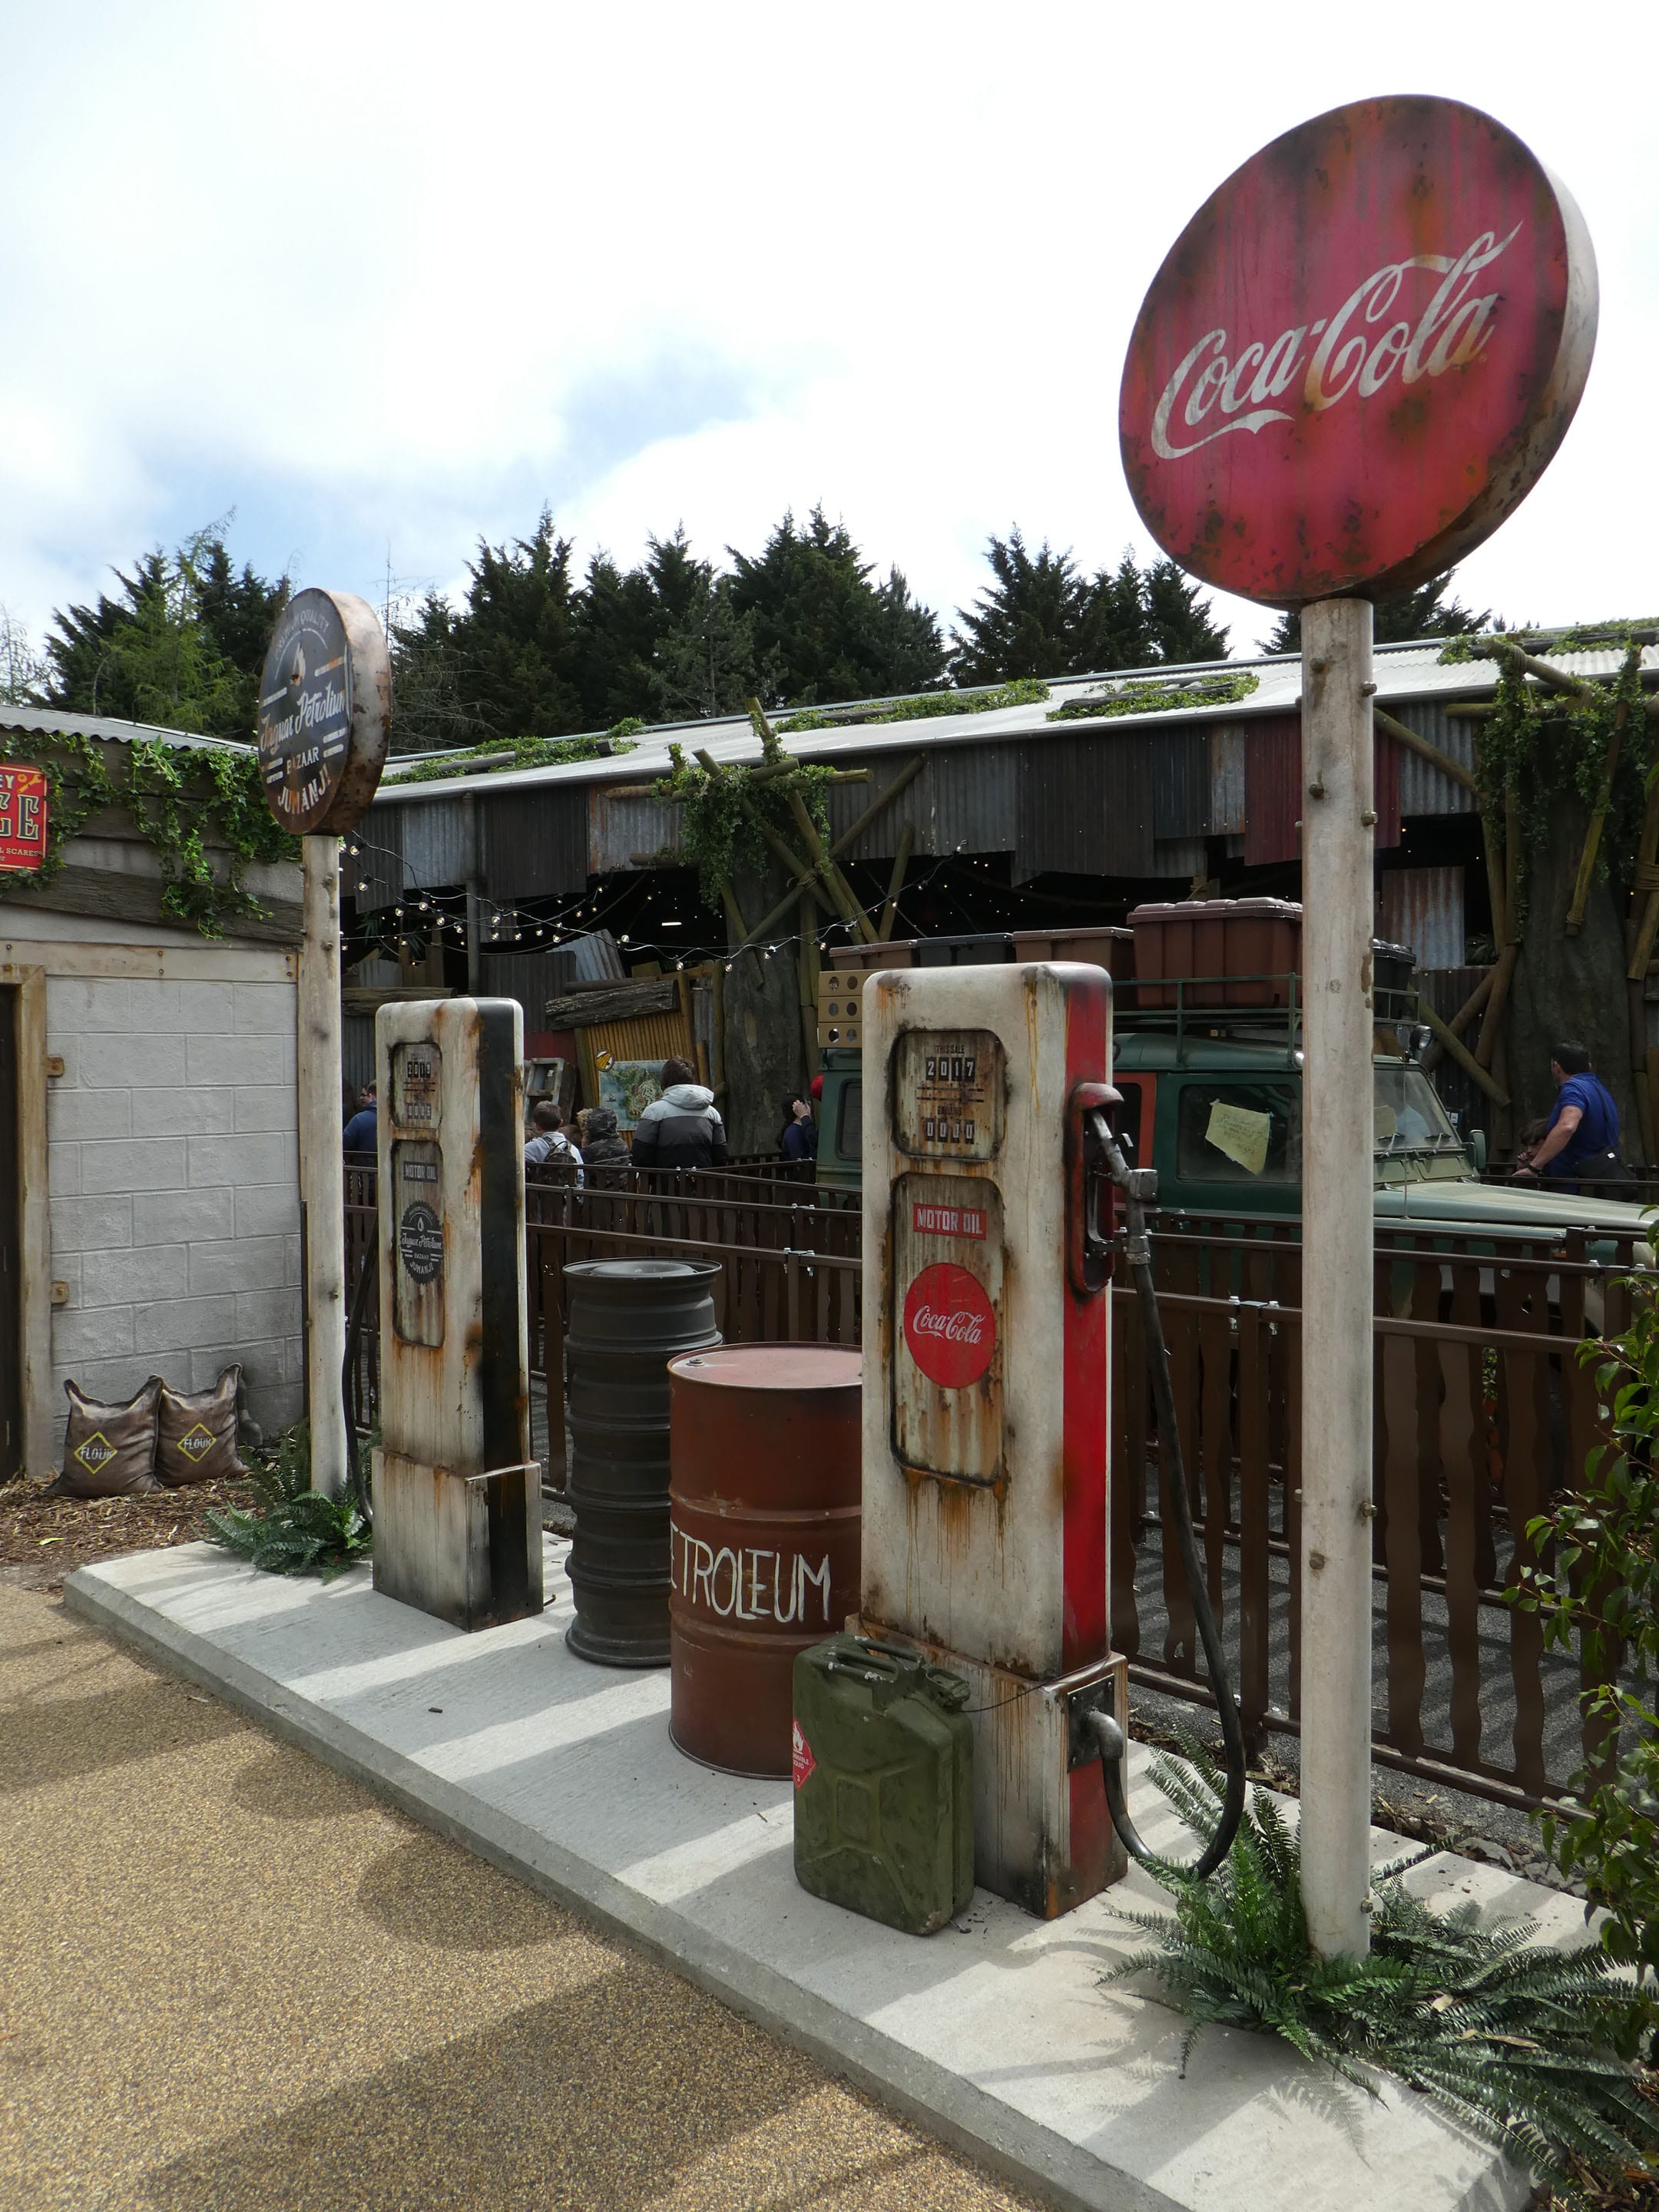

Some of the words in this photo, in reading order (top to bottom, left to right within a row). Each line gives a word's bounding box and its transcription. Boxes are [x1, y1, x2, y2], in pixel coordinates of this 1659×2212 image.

[1152, 220, 1523, 459] Coca-Cola
[260, 713, 295, 756] Jaguar
[286, 746, 320, 775] BAZAAR
[277, 763, 332, 815] JUMANJI
[950, 1045, 965, 1054] SALE
[927, 1061, 975, 1077] 2017
[405, 1164, 426, 1179] MOTOR
[426, 1166, 437, 1181] OIL
[916, 1208, 959, 1232] MOTOR
[962, 1213, 983, 1234] OIL
[409, 1261, 434, 1274] JUMANJI
[912, 1306, 986, 1345] Coca-Cola
[80, 1446, 113, 1460] FLOUR
[184, 1438, 212, 1451] FLOUR
